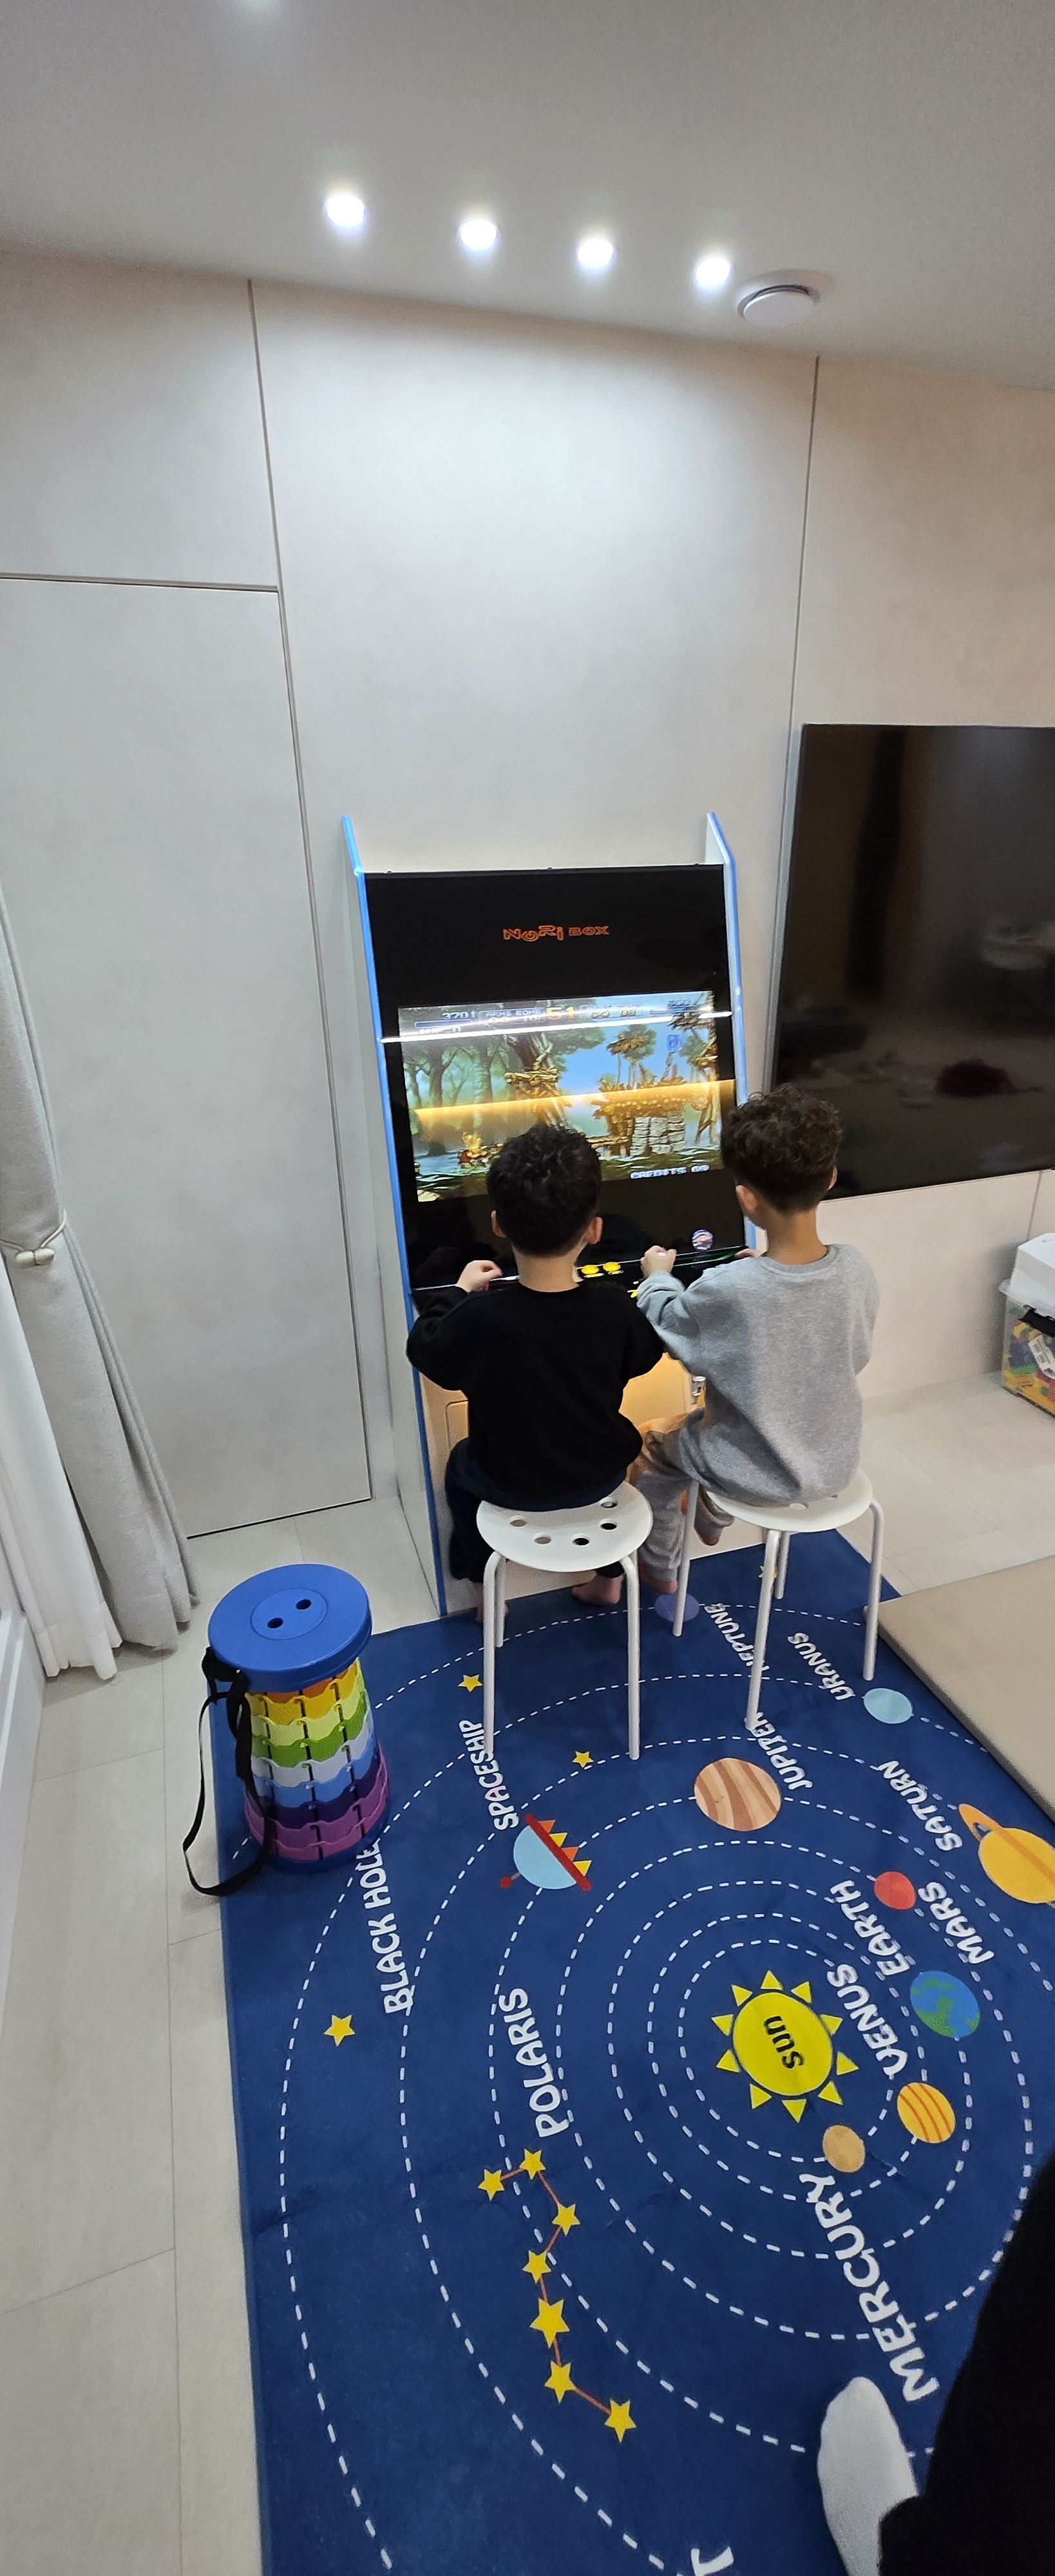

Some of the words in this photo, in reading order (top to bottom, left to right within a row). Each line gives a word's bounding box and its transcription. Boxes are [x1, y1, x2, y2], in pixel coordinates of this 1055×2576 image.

[568, 925, 610, 936] BOX
[547, 1007, 577, 1021] 51
[631, 1166, 687, 1179] CREDITS
[787, 1632, 856, 1701] URANUS
[459, 1720, 519, 1830] SPACESHIP
[879, 1759, 963, 1852] SATURN
[368, 1913, 413, 2014] BLACK
[830, 1879, 910, 1976] EARTH
[917, 1881, 994, 1964] MARS
[499, 1987, 569, 2138] POLARIS
[827, 1964, 909, 2076] VENUS
[799, 2172, 940, 2402] MERCURY
